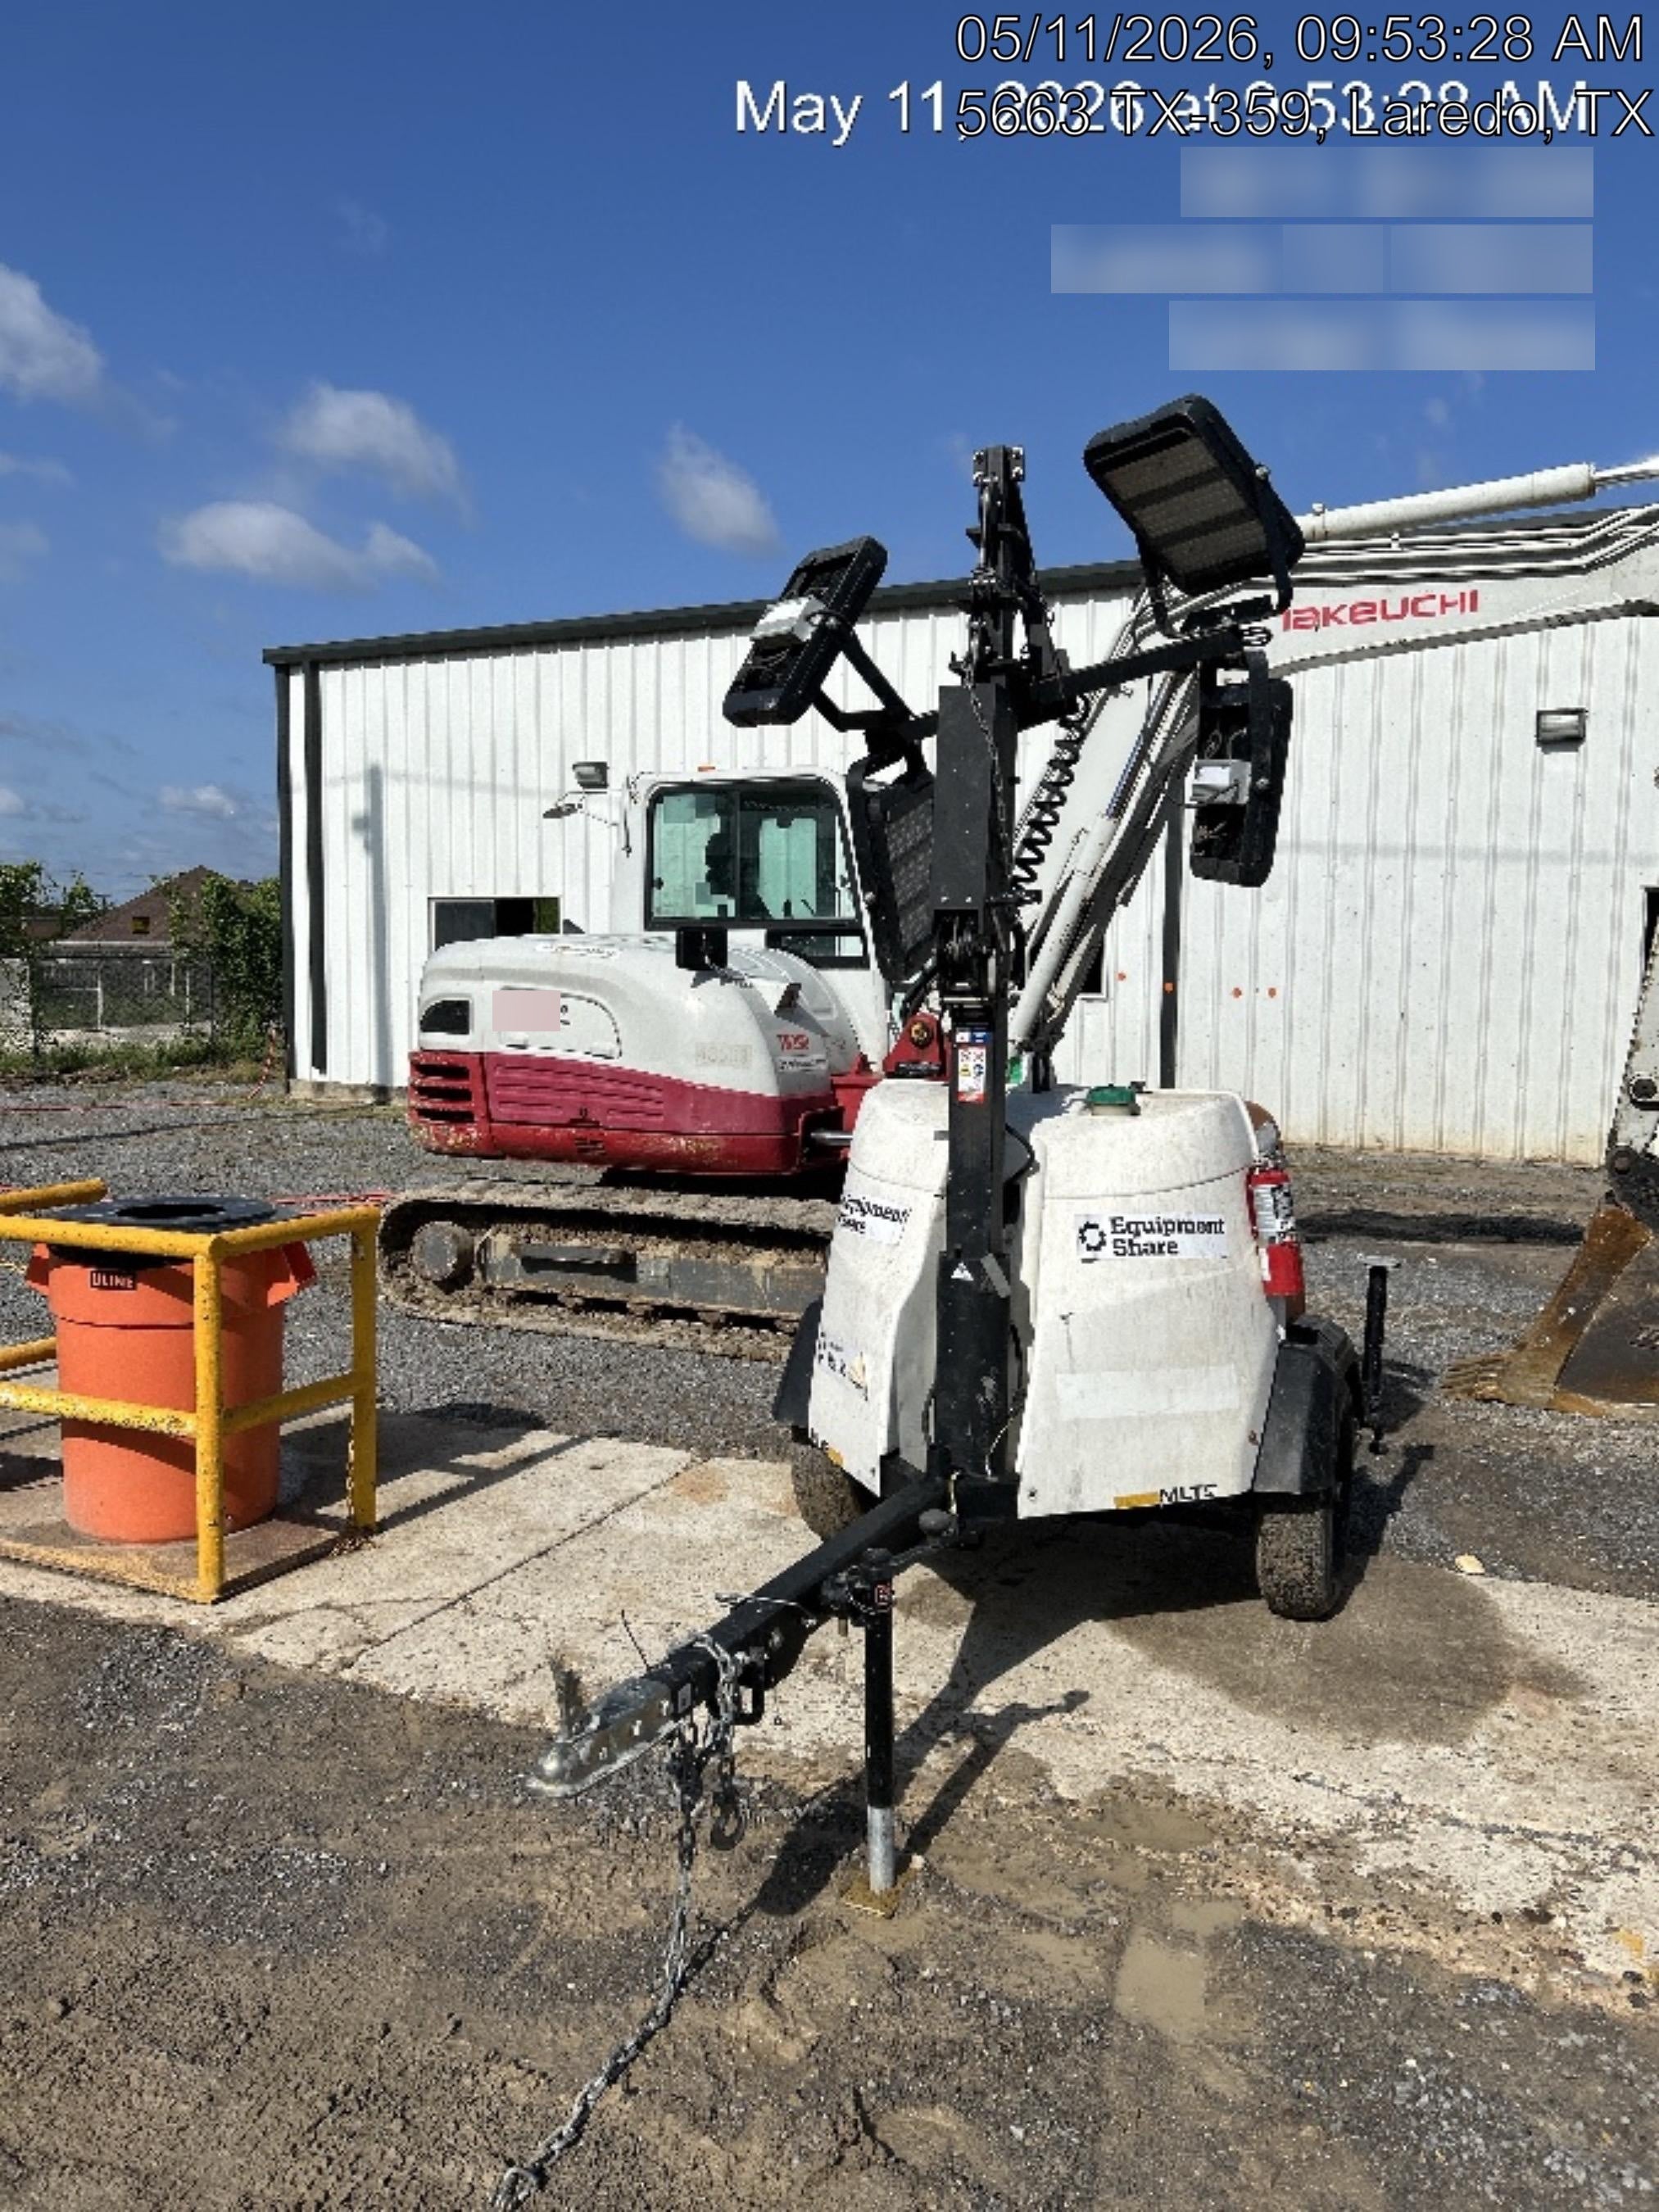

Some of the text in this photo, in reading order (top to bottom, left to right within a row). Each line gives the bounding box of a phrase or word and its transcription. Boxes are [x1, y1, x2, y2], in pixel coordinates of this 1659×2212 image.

[1109, 1216, 1225, 1236] Equipment
[1113, 1238, 1179, 1257] Share
[92, 1272, 134, 1288] ULINE
